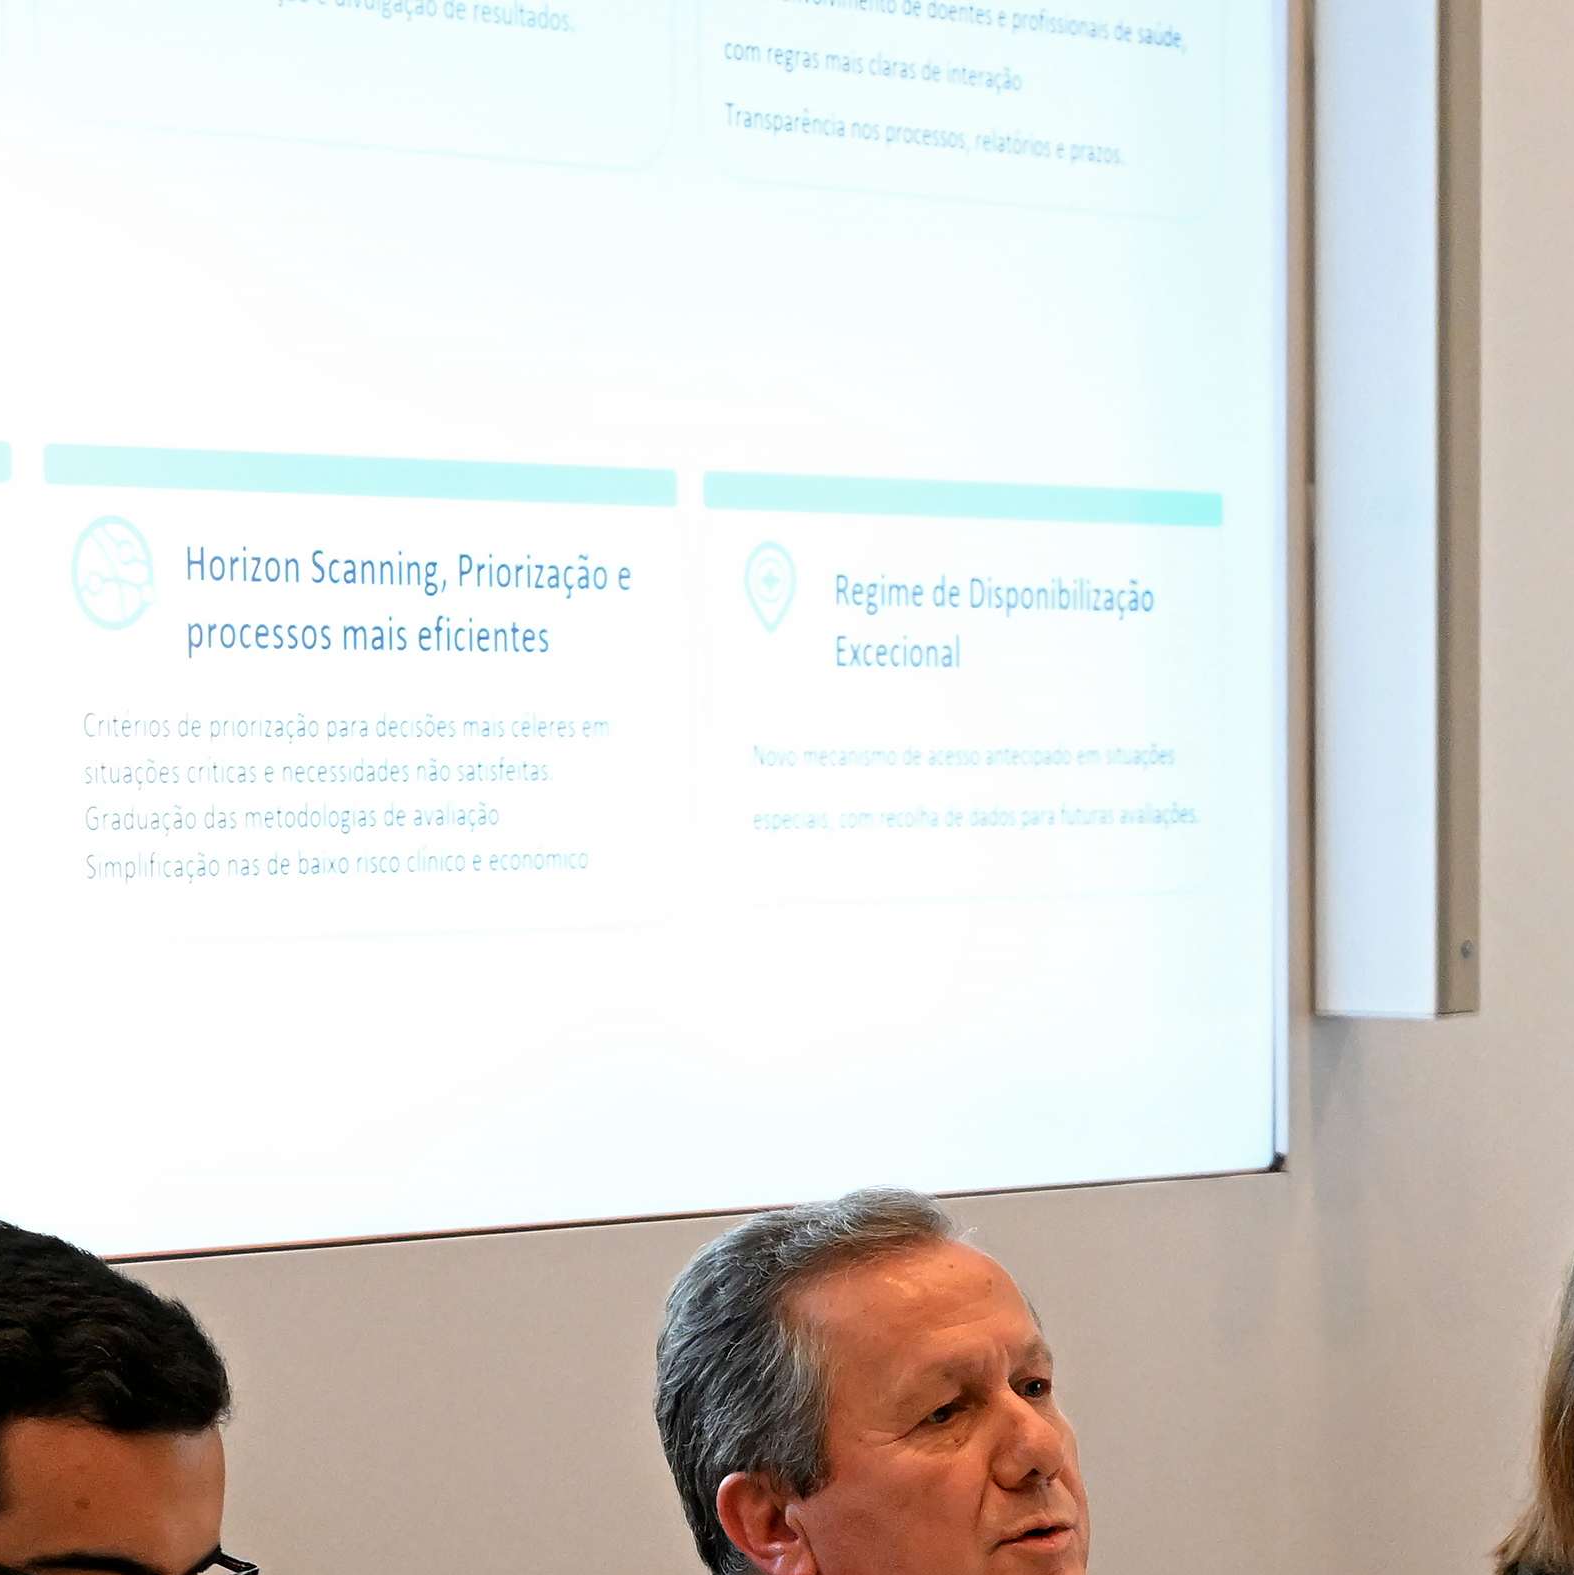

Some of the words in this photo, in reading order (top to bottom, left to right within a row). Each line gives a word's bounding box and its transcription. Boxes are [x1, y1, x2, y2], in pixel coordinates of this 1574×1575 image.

[998, 10, 1007, 28] e
[1012, 9, 1109, 41] profissionais
[1113, 19, 1132, 43] de
[725, 41, 762, 64] com
[767, 46, 820, 74] regras
[826, 51, 865, 75] mais
[869, 52, 917, 80] claras
[921, 57, 942, 83] de
[946, 62, 1024, 96] interação
[725, 102, 846, 144] Transparência
[851, 120, 882, 142] nos
[886, 124, 971, 157] processos,
[976, 127, 1050, 159] relatórios
[1056, 142, 1066, 160] e
[185, 545, 301, 583] Horizon
[311, 549, 447, 597] Scanning,
[458, 553, 609, 599] Priorização
[618, 567, 632, 592] e
[836, 573, 925, 616] Regime
[933, 573, 961, 608] de
[969, 577, 1156, 621] Disponibilização
[186, 620, 332, 659] processos
[342, 615, 409, 652] mais
[418, 615, 551, 654] eficientes
[836, 634, 961, 668] Excecional
[177, 711, 203, 738] de
[210, 710, 320, 745] priorização
[326, 719, 369, 744] para
[375, 711, 458, 738] decisões
[463, 712, 505, 738] mais
[582, 718, 611, 738] em
[83, 757, 181, 791] situações
[263, 764, 275, 784] e
[282, 756, 410, 784] necessidades
[416, 757, 452, 783] não
[904, 745, 922, 767] de
[1077, 750, 1102, 767] em
[85, 804, 197, 837] Graduação
[204, 802, 238, 831] das
[244, 801, 377, 835] metodologias
[383, 801, 407, 828] de
[413, 800, 500, 832] avaliação
[85, 850, 221, 885] Simplificação
[228, 858, 261, 878] nas
[267, 850, 291, 878] de
[298, 848, 351, 876] baixo
[356, 850, 401, 875] risco
[472, 854, 483, 873] e
